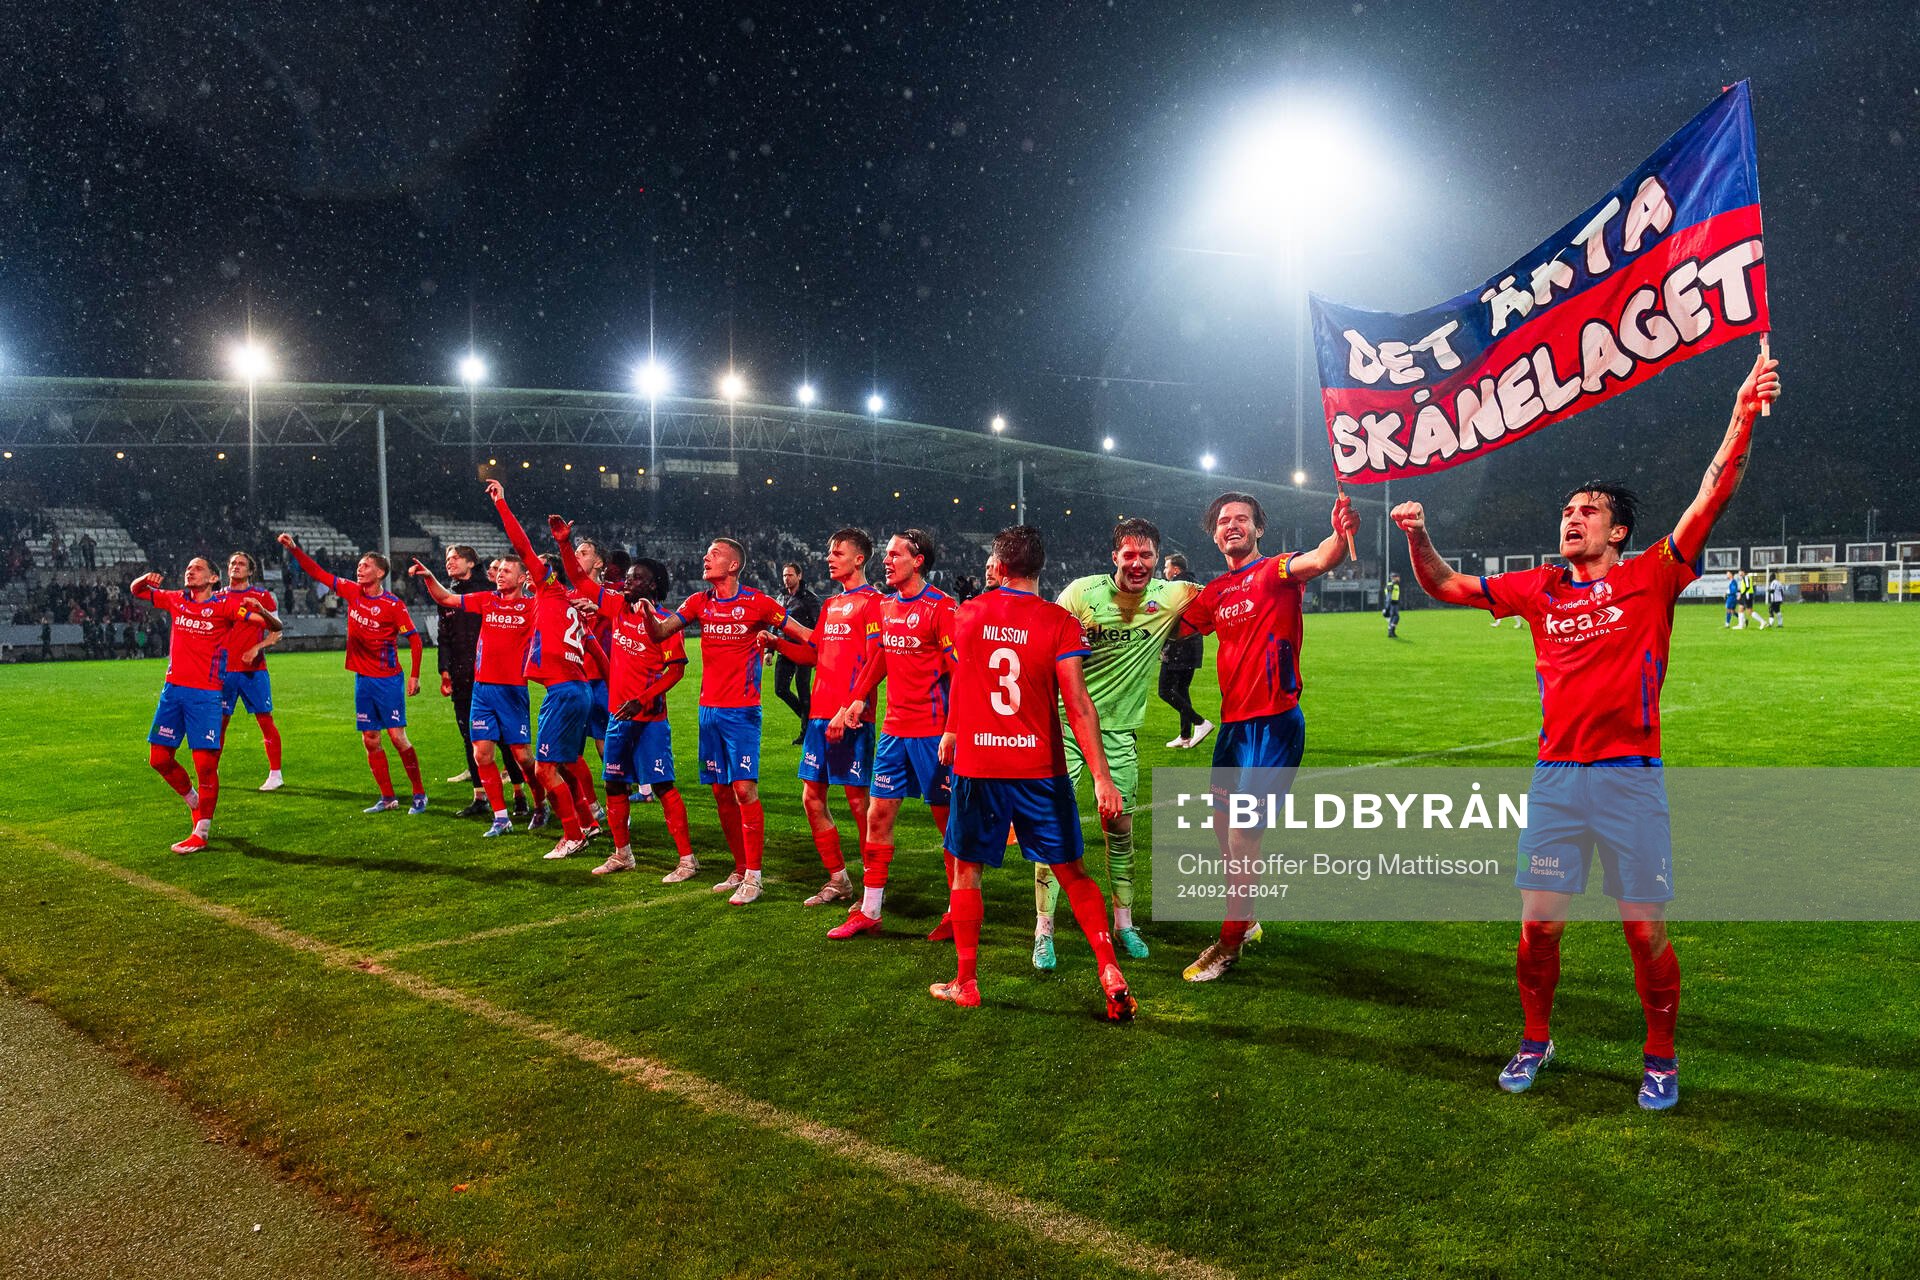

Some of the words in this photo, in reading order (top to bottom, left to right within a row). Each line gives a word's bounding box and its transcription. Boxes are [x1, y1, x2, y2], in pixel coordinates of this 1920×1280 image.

[1332, 240, 1763, 472] SKÅNELAGET
[1343, 320, 1462, 385] DET
[486, 612, 512, 624] akea
[703, 622, 732, 634] akea
[824, 621, 839, 635] kea
[983, 625, 1028, 644] NILSSON
[1086, 624, 1131, 641] akea
[988, 647, 1021, 716] 3
[974, 733, 1036, 748] tillmobil
[742, 755, 751, 763] 20
[852, 761, 860, 769] 21
[875, 774, 891, 784] Solid
[1531, 855, 1559, 868] Solid
